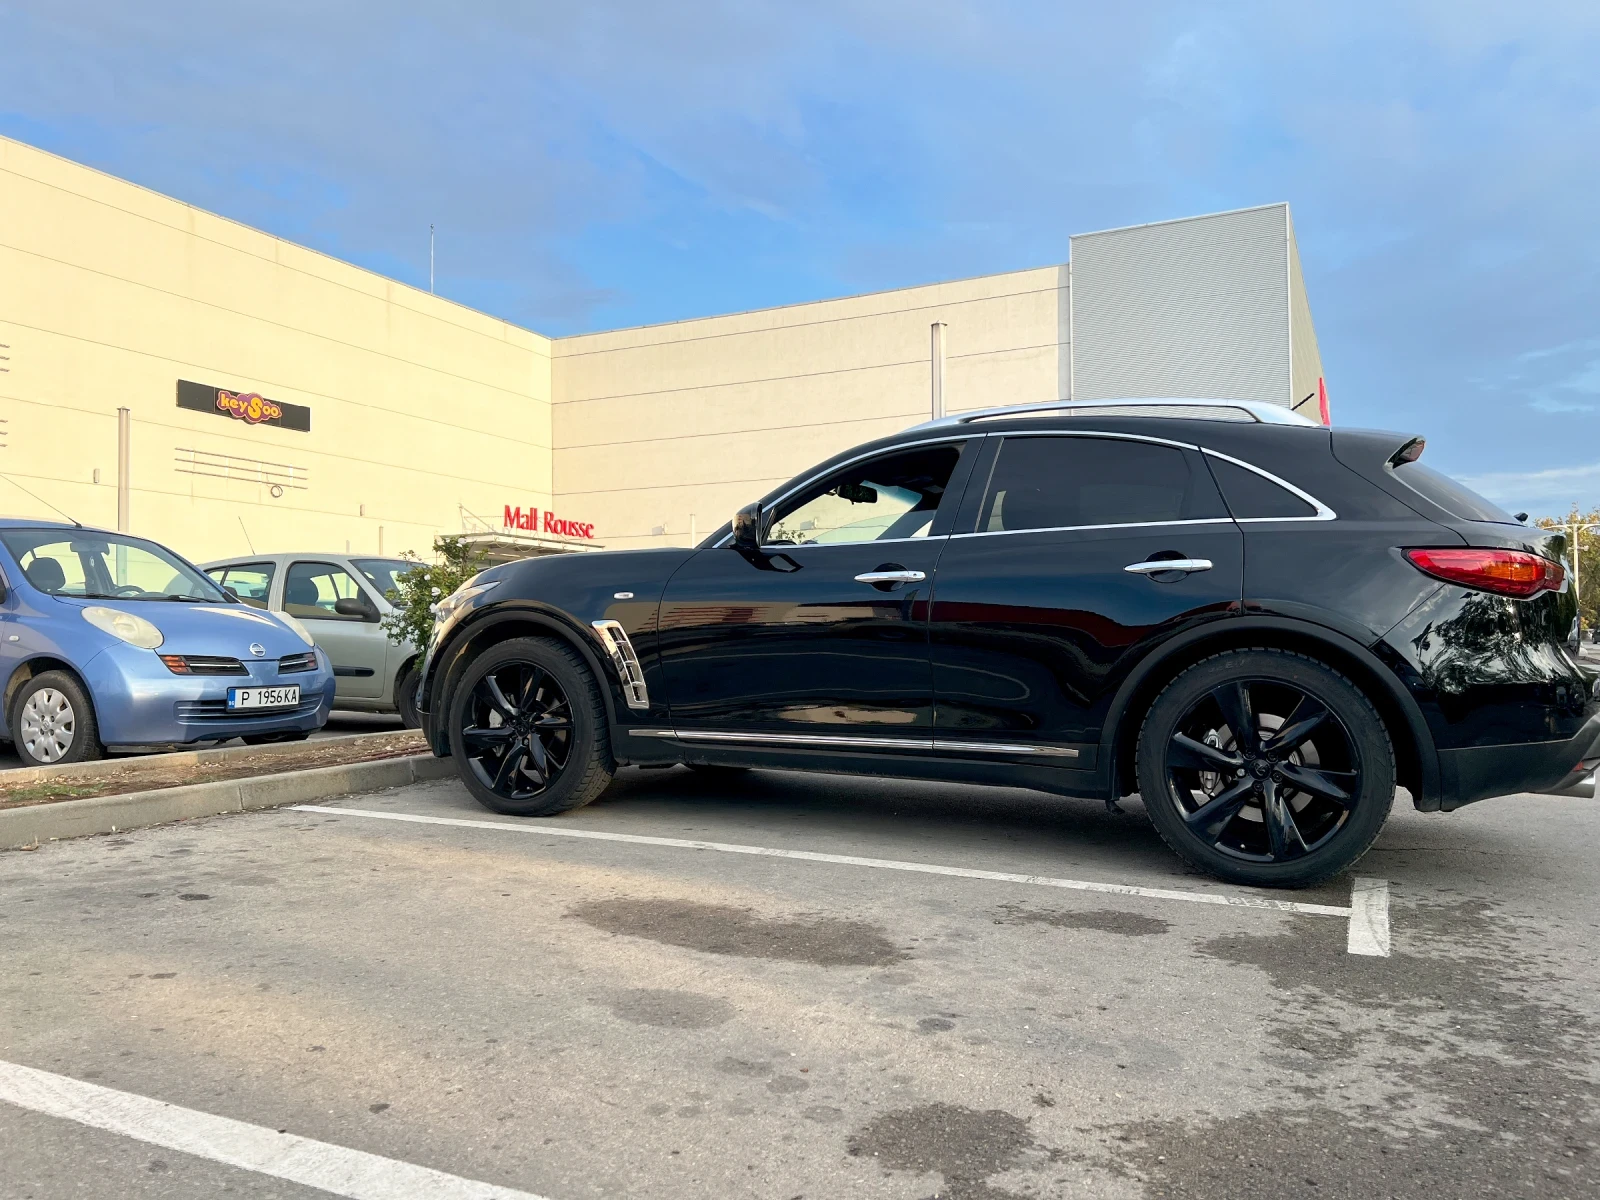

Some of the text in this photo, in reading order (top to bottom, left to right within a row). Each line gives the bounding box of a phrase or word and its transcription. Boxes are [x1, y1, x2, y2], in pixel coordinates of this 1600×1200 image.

[503, 504, 594, 539] Mall Rousse
[241, 691, 250, 706] P
